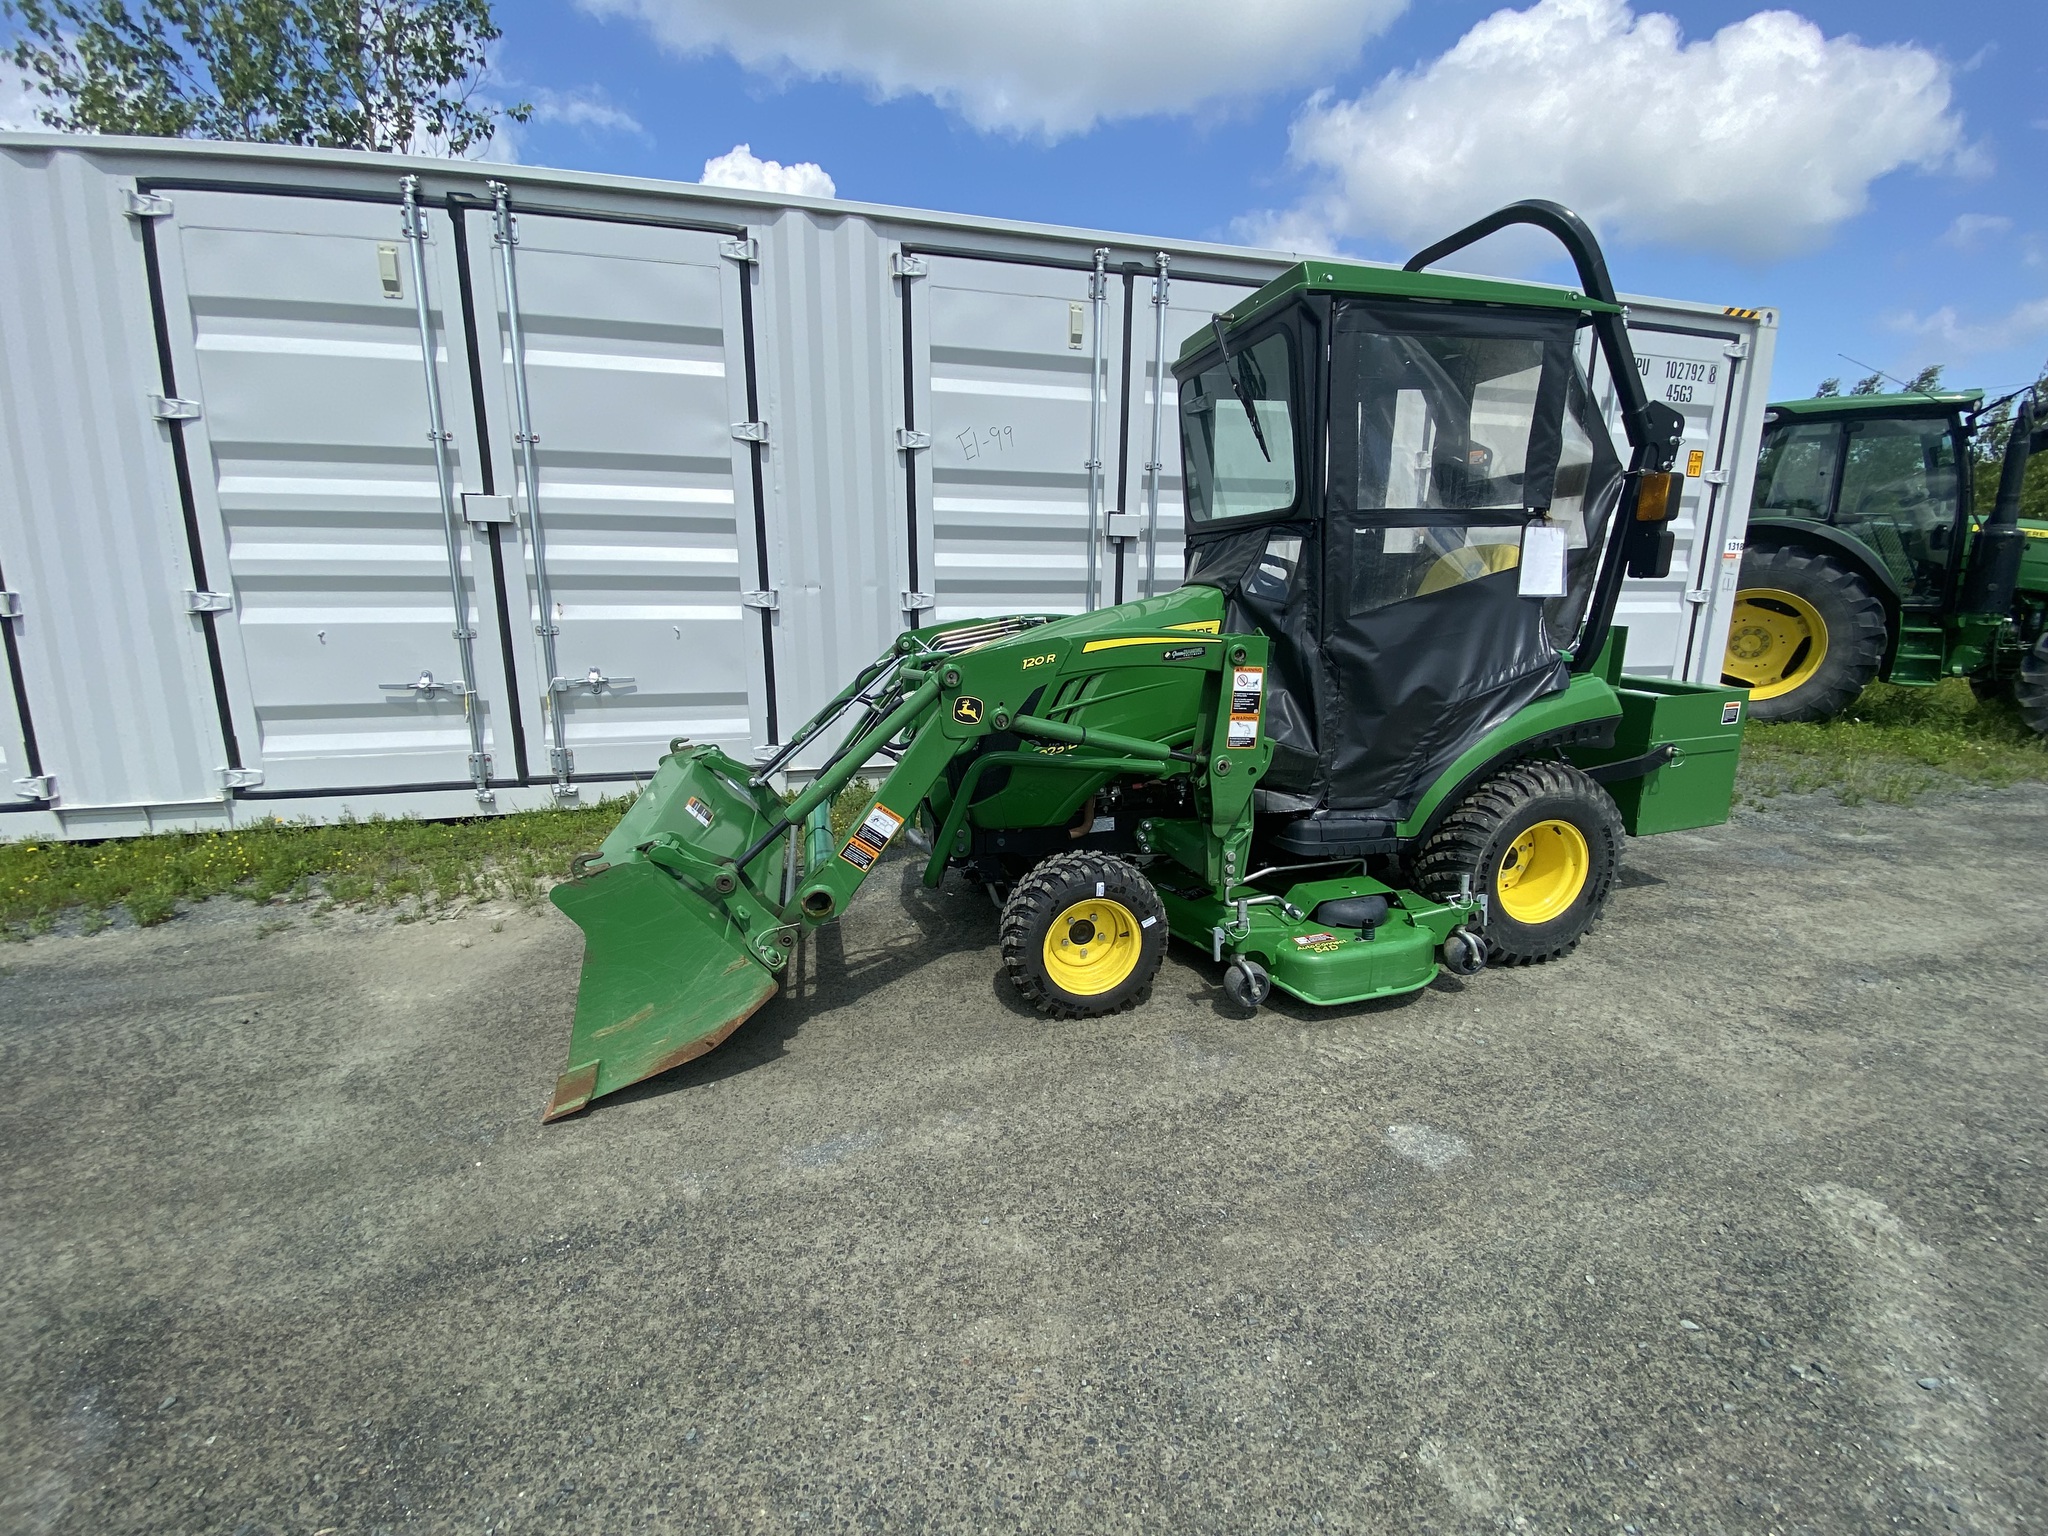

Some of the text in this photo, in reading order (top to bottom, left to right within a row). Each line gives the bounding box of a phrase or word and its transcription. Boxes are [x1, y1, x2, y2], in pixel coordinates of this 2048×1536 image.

[1665, 360, 1705, 382] 102792
[1709, 366, 1717, 383] 8
[1665, 384, 1693, 403] 45G3
